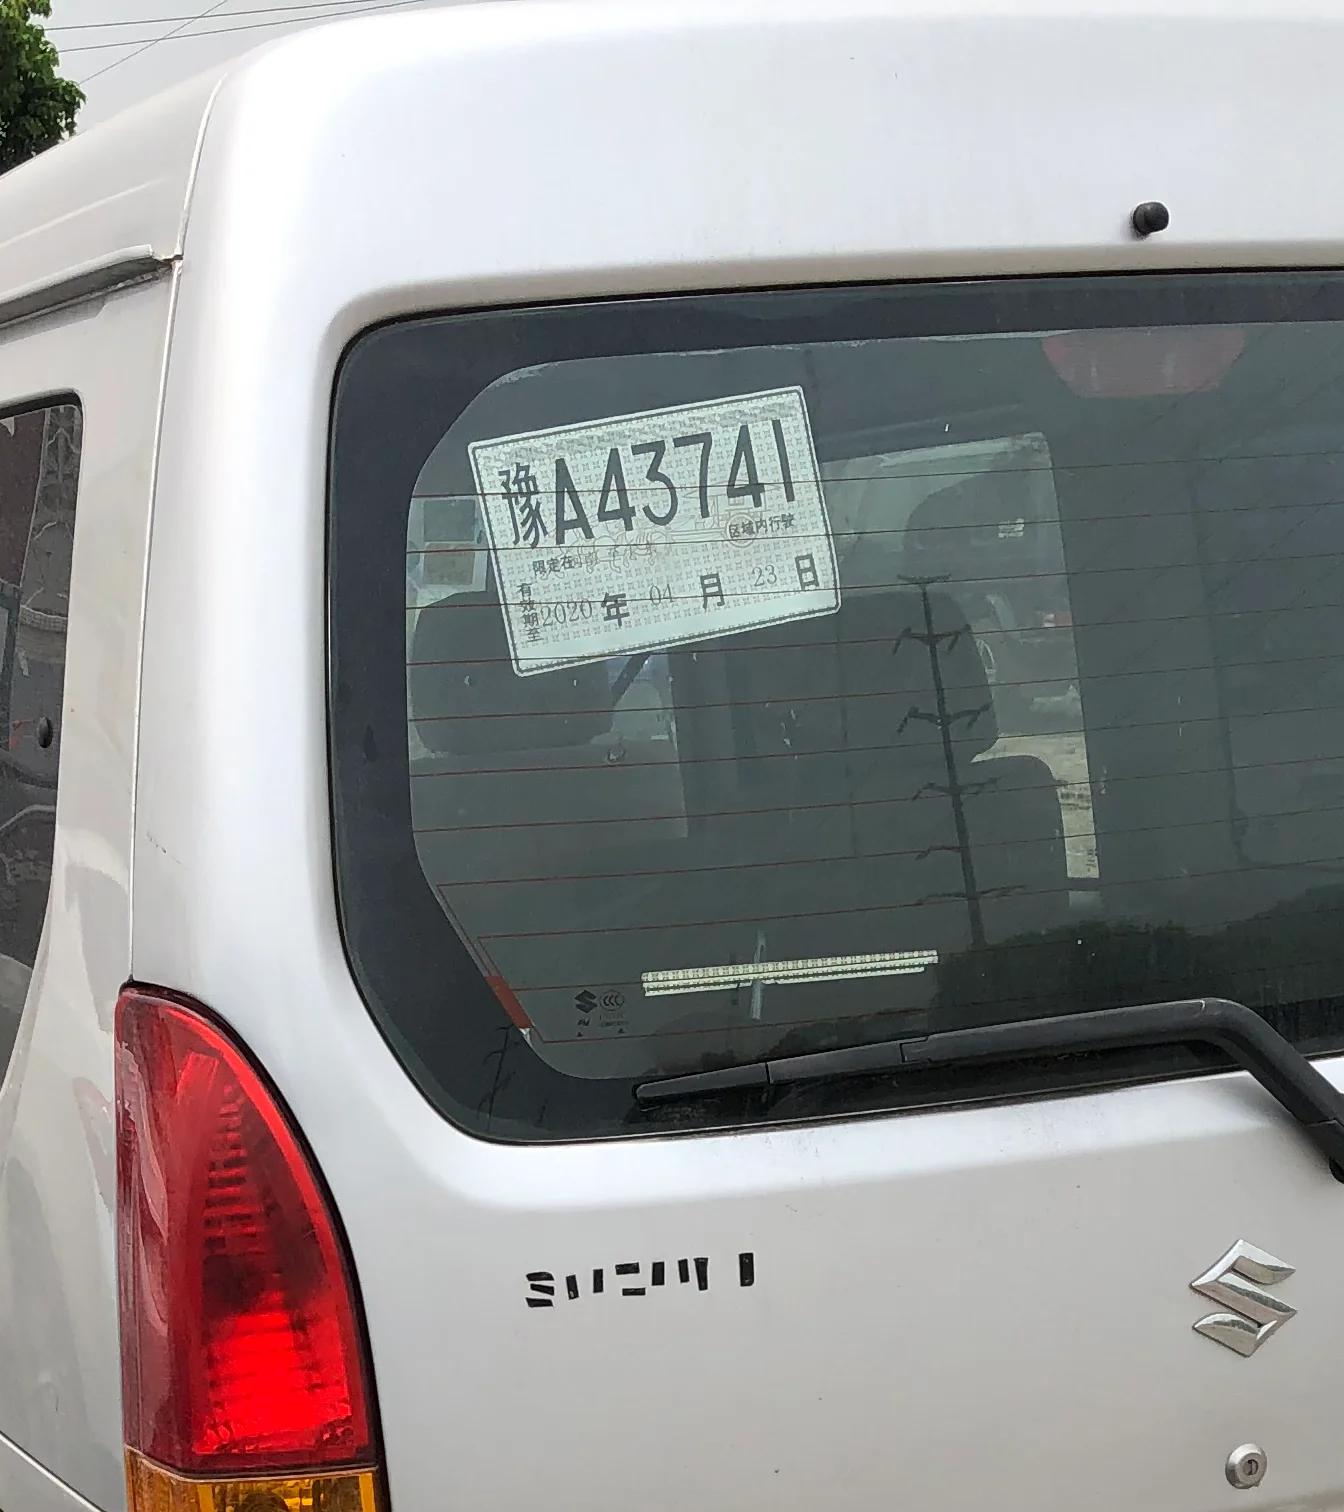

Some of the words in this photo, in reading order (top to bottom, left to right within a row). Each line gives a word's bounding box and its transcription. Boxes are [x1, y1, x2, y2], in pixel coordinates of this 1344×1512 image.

[498, 418, 795, 550] 豫A43741
[540, 599, 593, 627] 2020
[600, 592, 630, 628] 年
[700, 572, 726, 609] 月
[751, 564, 778, 587] 23
[794, 553, 820, 591] 日
